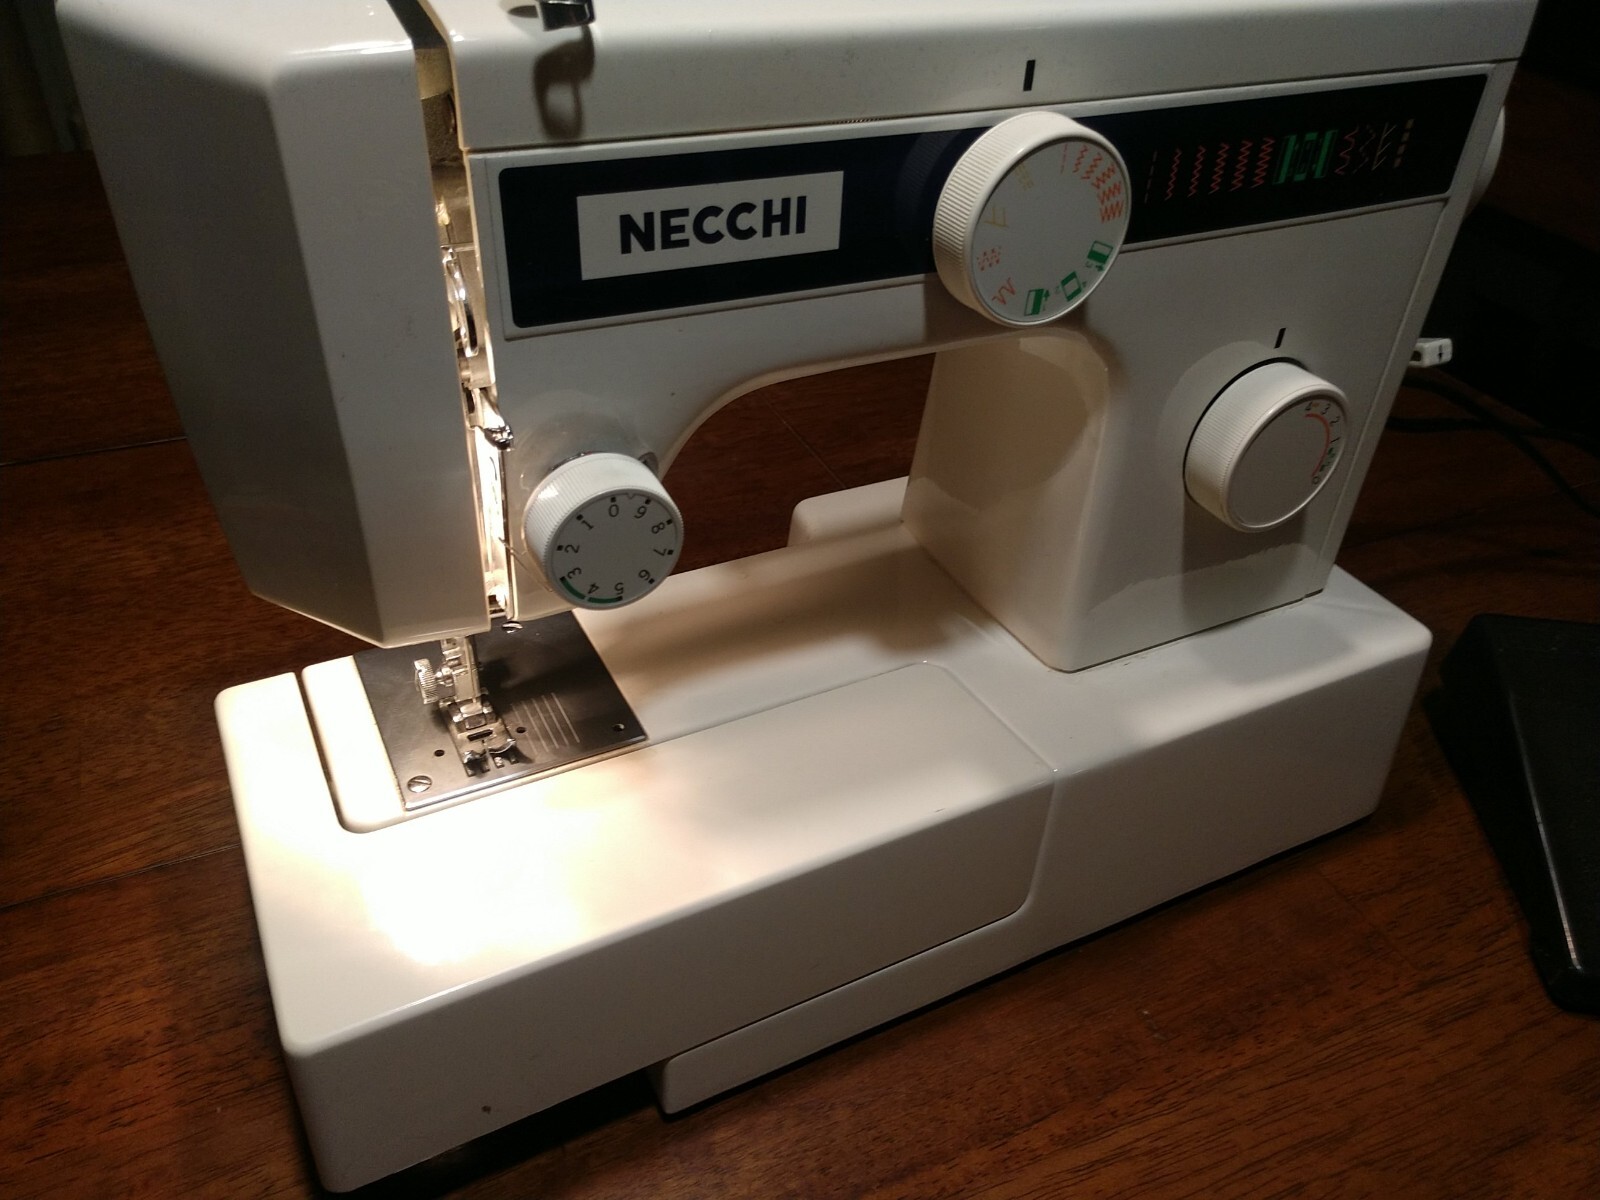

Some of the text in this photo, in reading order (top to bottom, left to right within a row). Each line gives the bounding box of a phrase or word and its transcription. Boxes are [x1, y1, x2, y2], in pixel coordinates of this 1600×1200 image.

[619, 195, 807, 255] NECCHI
[608, 503, 619, 518] 0
[634, 505, 647, 519] 9
[581, 519, 594, 530] 1
[651, 522, 665, 534] 8
[564, 544, 580, 553] 2
[653, 548, 667, 556] 7
[567, 567, 582, 579] 3
[638, 569, 651, 581] 6
[588, 582, 600, 594] 4
[614, 582, 624, 595] 5
